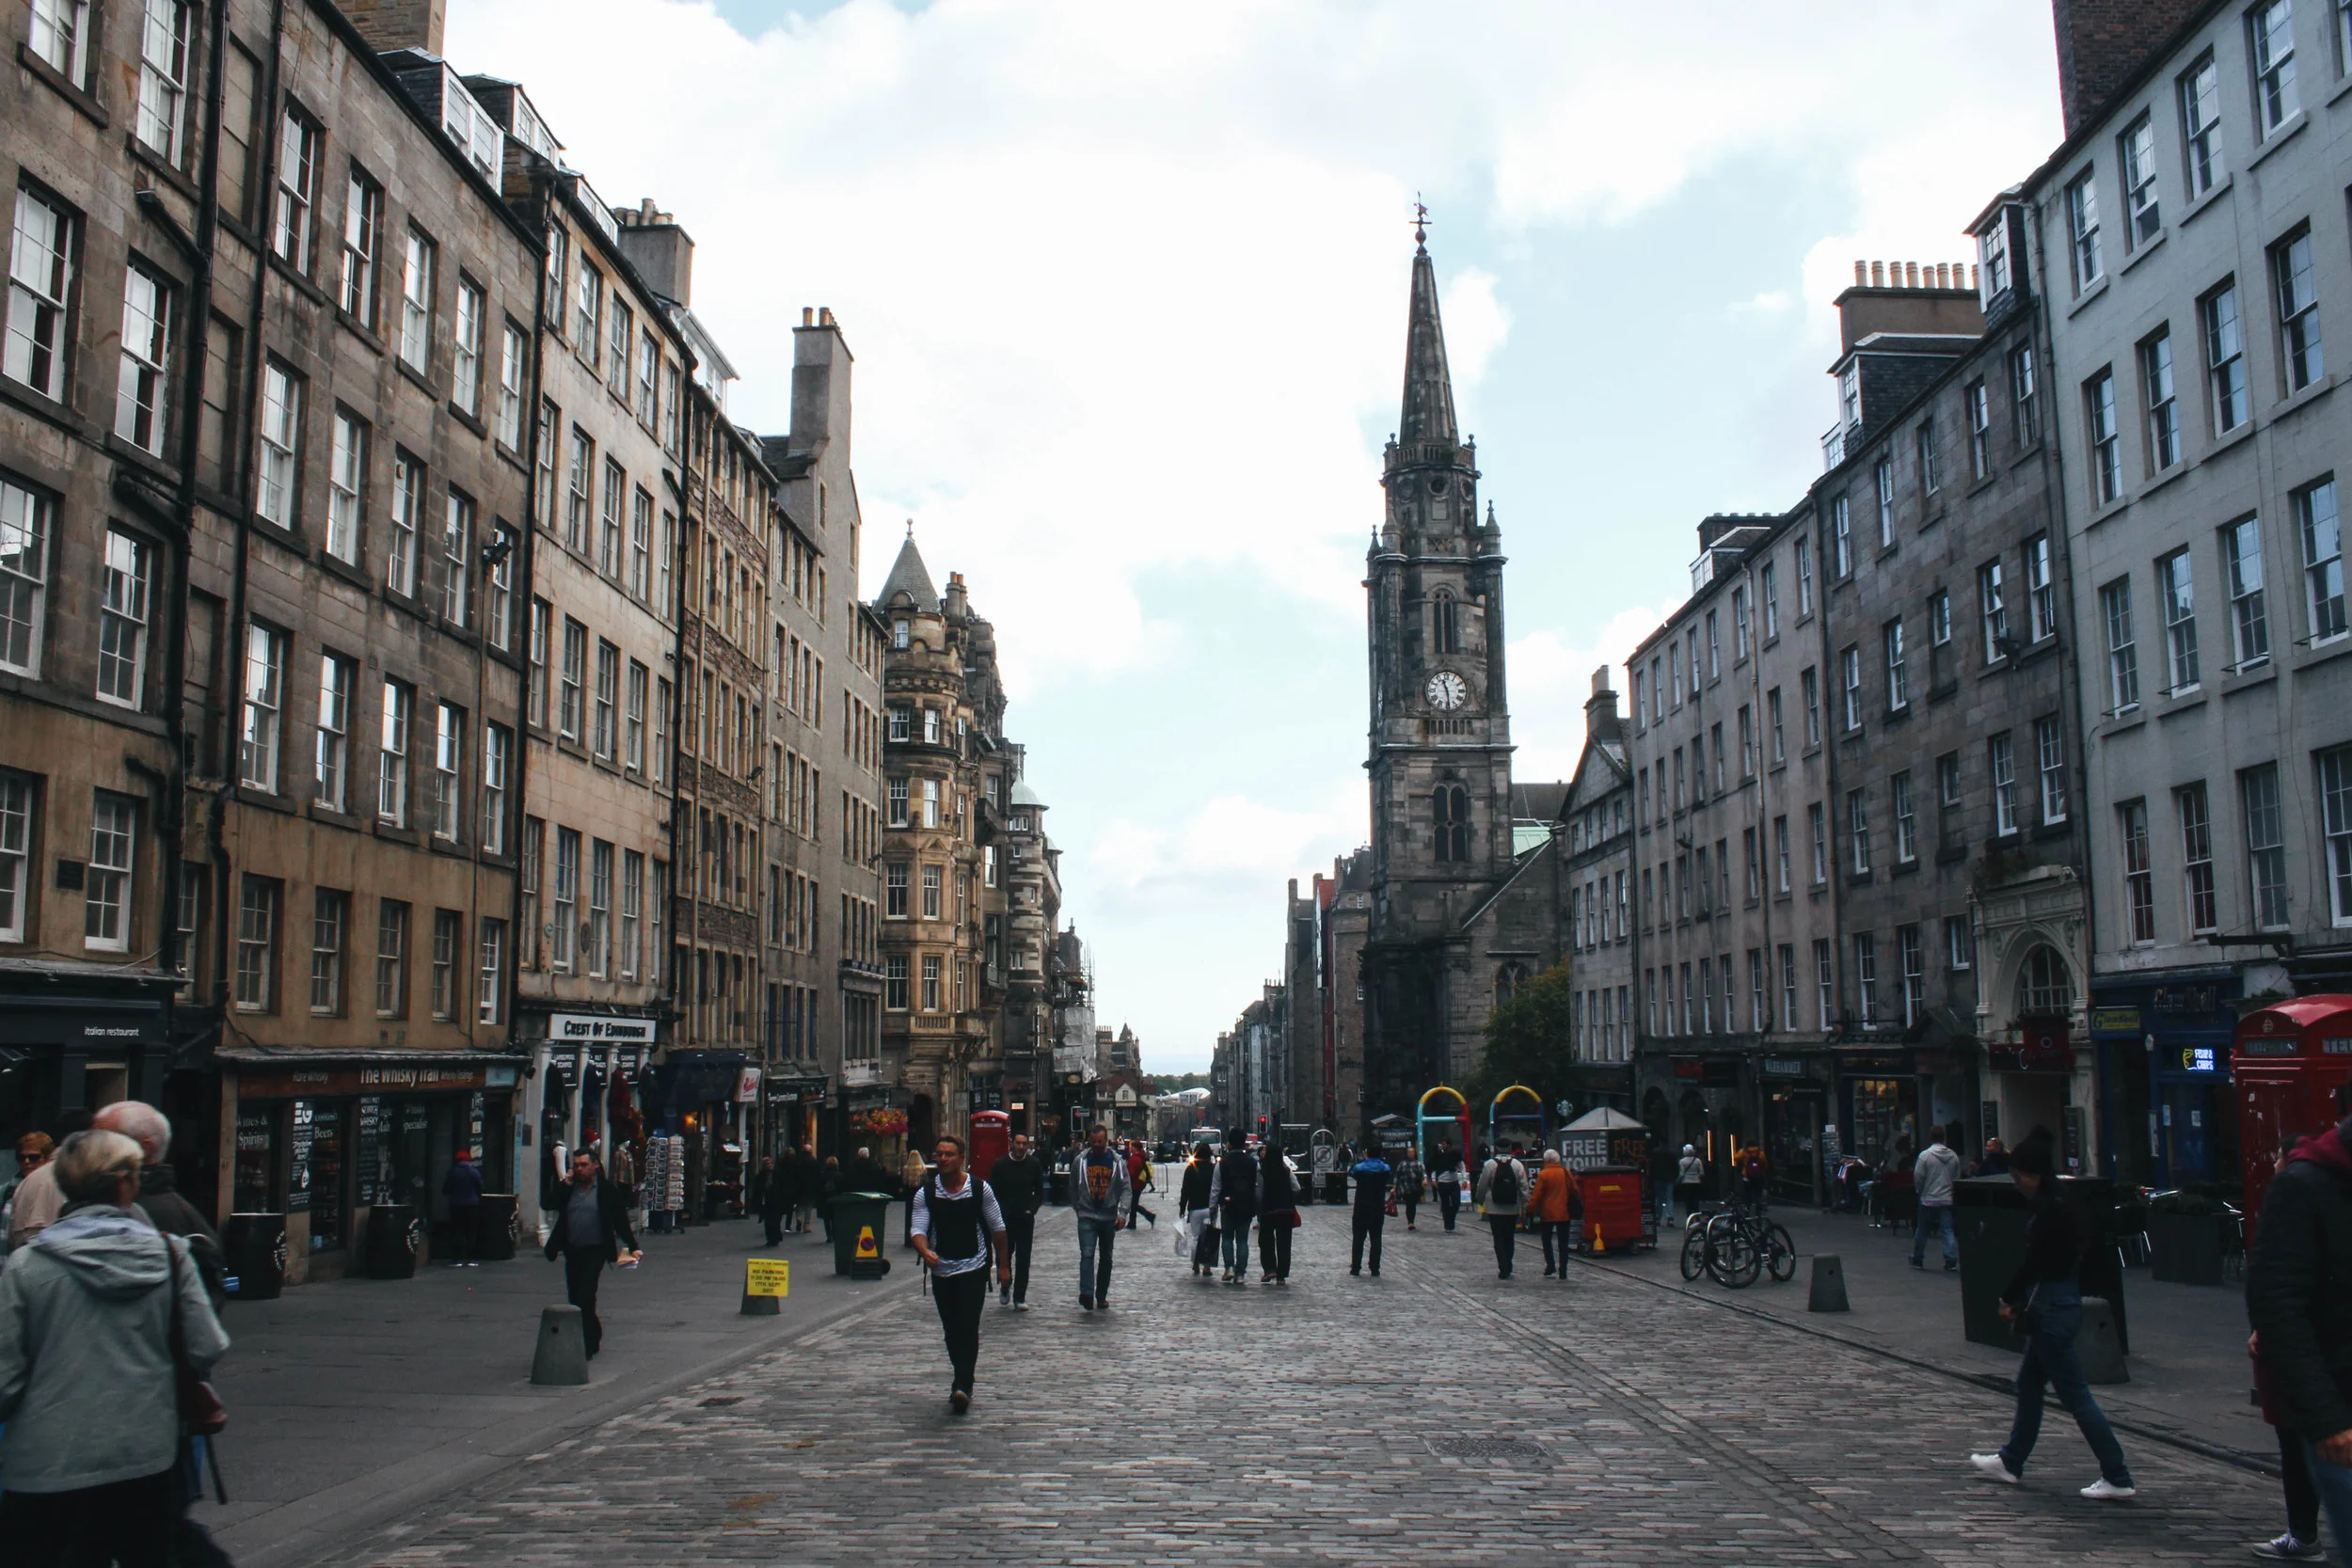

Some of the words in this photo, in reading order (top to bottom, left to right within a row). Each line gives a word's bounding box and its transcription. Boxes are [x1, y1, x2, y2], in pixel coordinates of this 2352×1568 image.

[84, 1025, 105, 1036] italian
[106, 1027, 139, 1037] restaurant
[564, 1021, 591, 1036] CREST
[593, 1022, 604, 1036] OF
[605, 1022, 646, 1037] EDINBURGH
[359, 1064, 380, 1084] The
[381, 1064, 419, 1088] Whisky
[419, 1064, 439, 1082] Trail
[314, 1127, 334, 1139] Beers
[1562, 1140, 1607, 1155] FREE
[1613, 1138, 1645, 1159] FREE
[1563, 1157, 1608, 1172] TOUR
